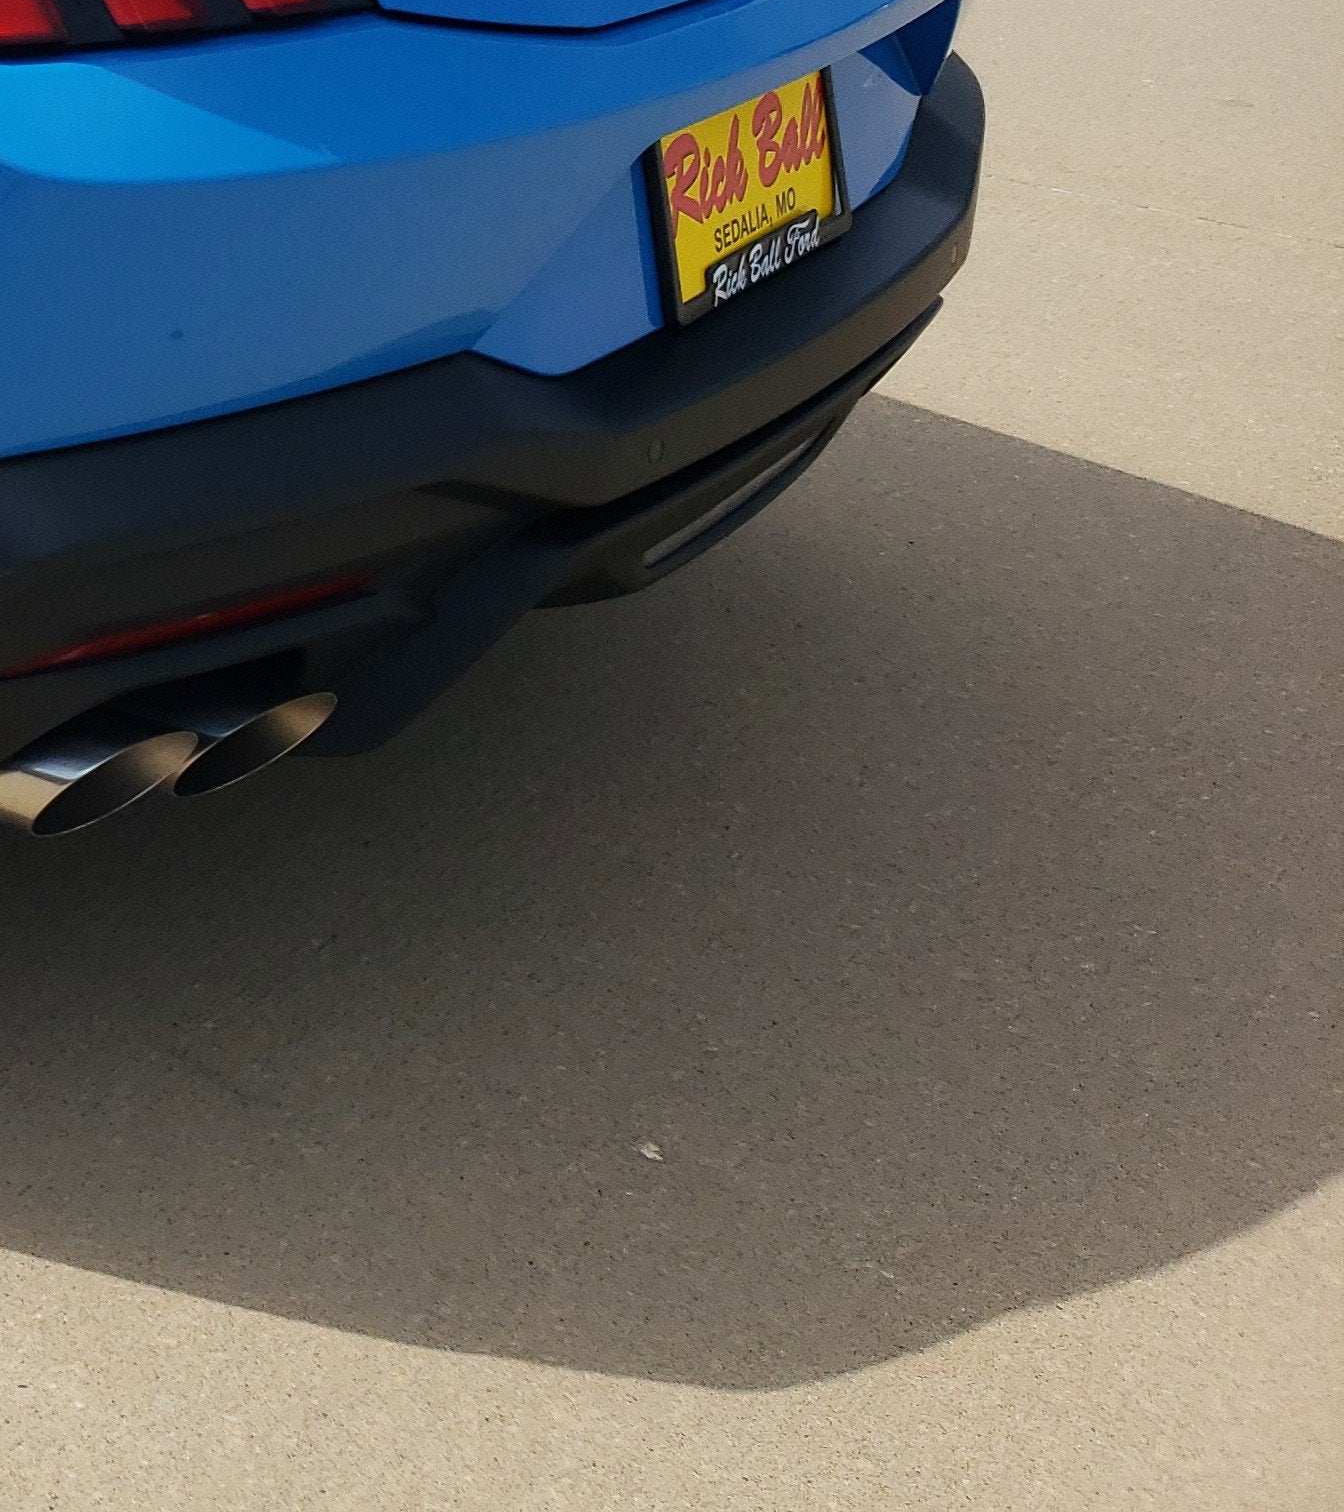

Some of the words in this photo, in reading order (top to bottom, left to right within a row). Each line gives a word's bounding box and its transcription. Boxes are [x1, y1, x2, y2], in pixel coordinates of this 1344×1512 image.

[664, 113, 749, 240] Rick
[751, 76, 826, 188] Ball
[712, 252, 748, 307] Rick
[749, 236, 782, 283] Ball
[784, 216, 821, 264] Ford
[714, 202, 773, 253] SEDALIA,
[775, 186, 796, 218] MO
